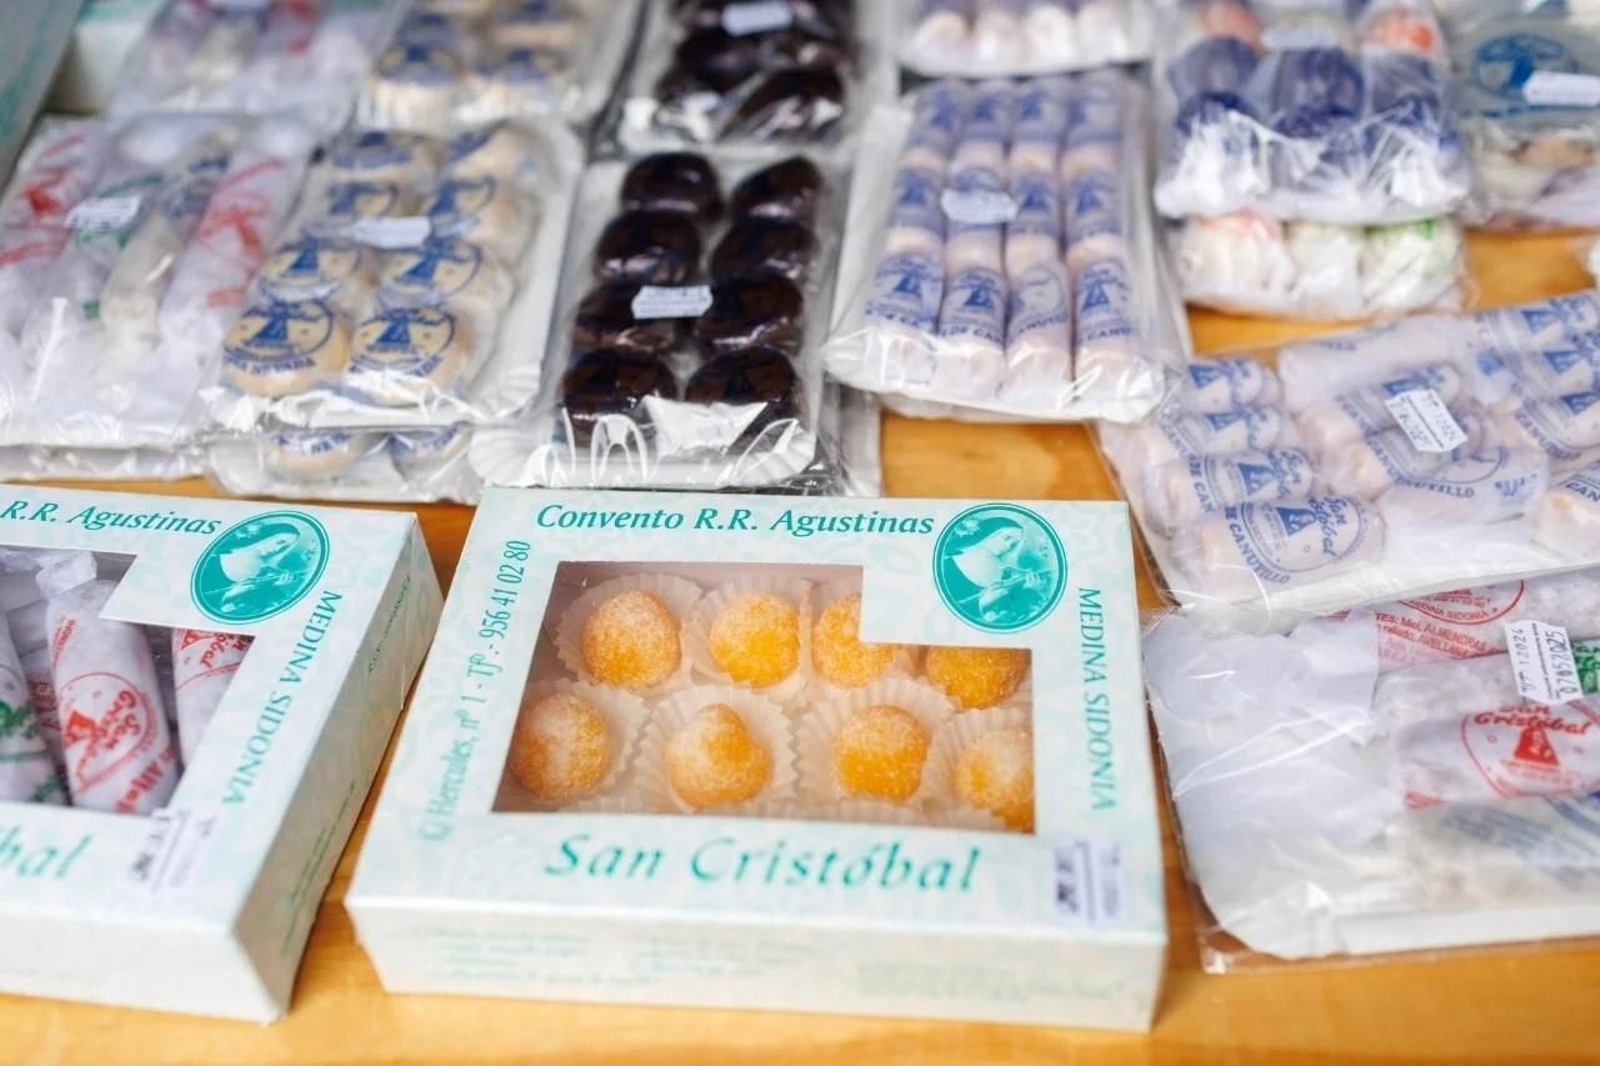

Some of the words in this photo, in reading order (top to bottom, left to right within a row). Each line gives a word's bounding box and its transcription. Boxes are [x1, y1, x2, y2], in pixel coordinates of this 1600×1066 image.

[1, 500, 58, 522] R.R.
[66, 505, 222, 535] Agustinas
[537, 505, 684, 529] Convento
[693, 508, 757, 531] R.R.
[770, 509, 934, 537] Agustinas
[499, 562, 528, 586] 02
[504, 540, 531, 562] 80
[1229, 523, 1291, 584] CANUTILLO
[491, 588, 519, 607] 41
[279, 590, 343, 684] MEDINA
[480, 609, 511, 640] 956
[1079, 587, 1108, 684] MEDINA
[221, 690, 292, 804] SIDONIA
[1084, 691, 1117, 811] SIDONIA
[544, 834, 664, 879] San
[689, 837, 981, 893] Cristóbal
